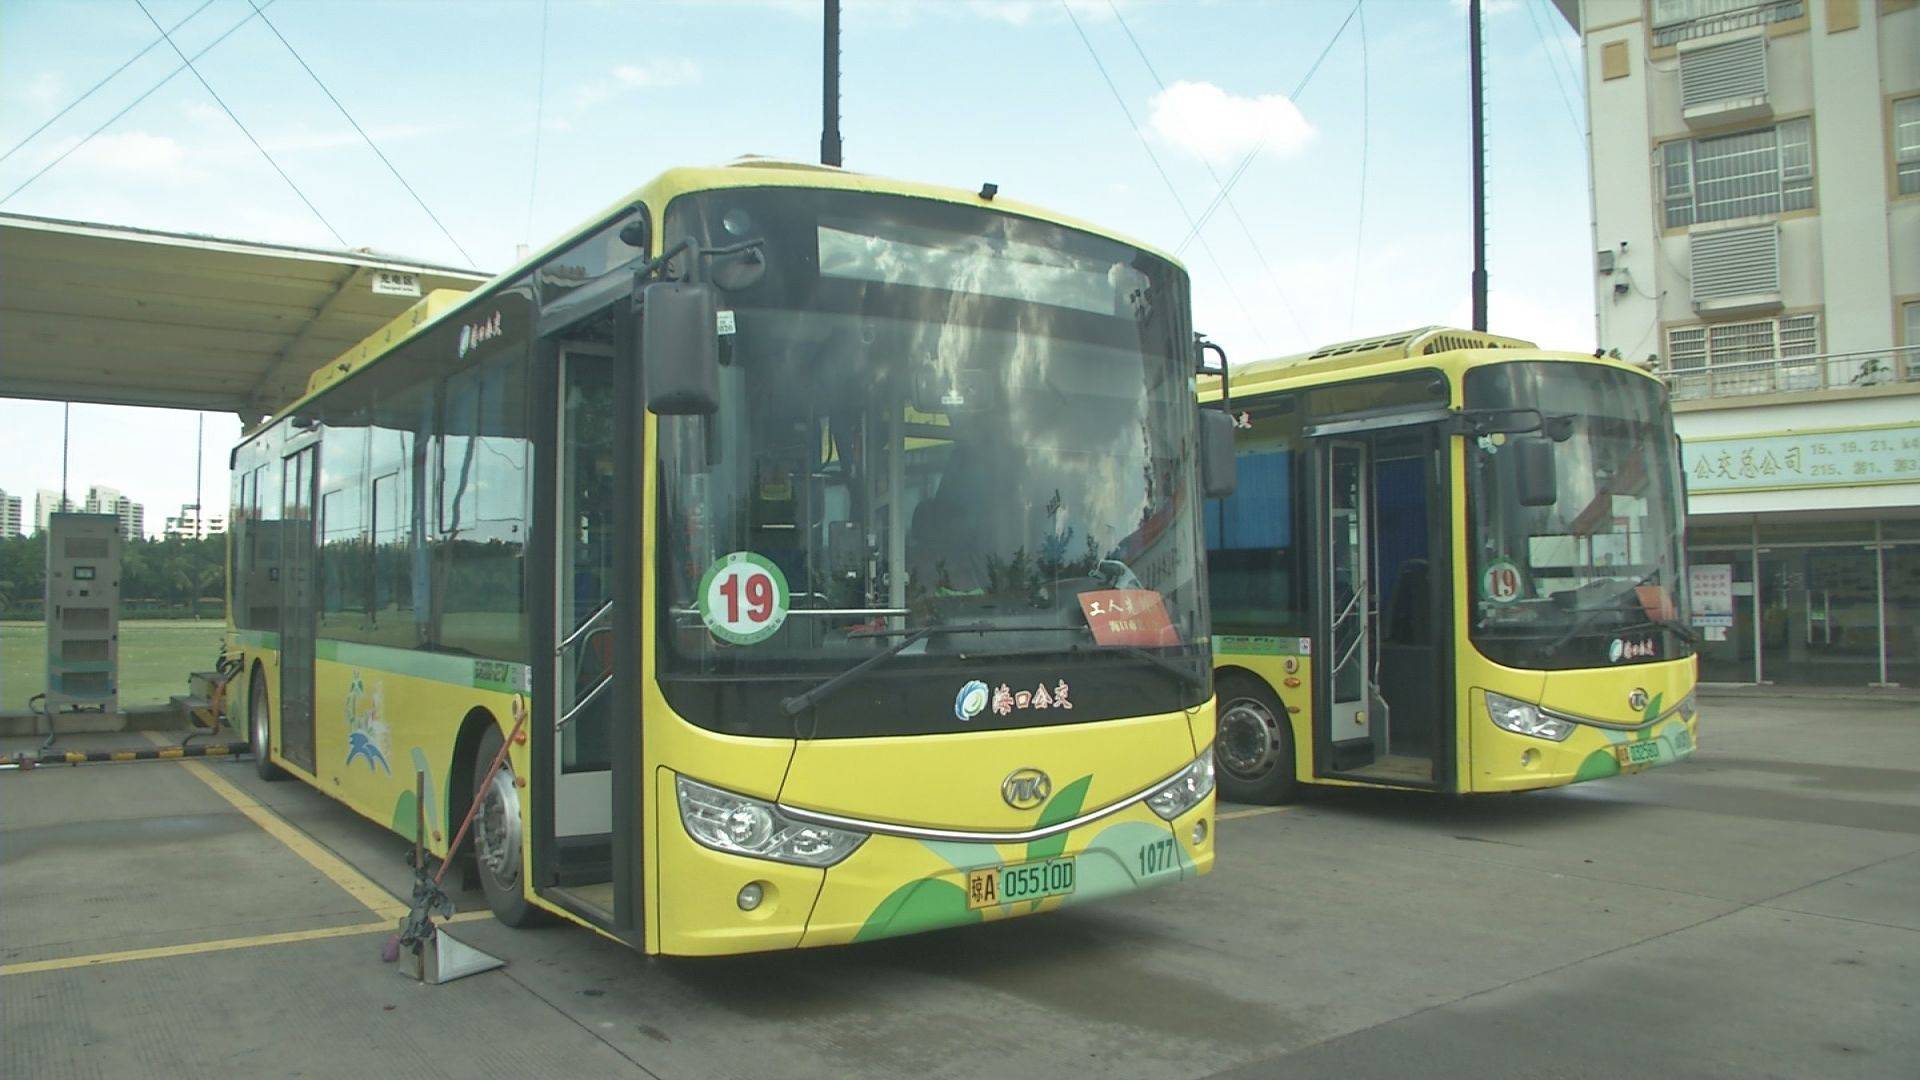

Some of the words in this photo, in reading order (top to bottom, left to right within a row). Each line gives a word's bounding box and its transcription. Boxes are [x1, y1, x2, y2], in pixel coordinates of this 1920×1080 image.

[1694, 446, 1803, 480] 公交总公司
[720, 573, 773, 623] 19
[1489, 569, 1517, 597] 19
[992, 679, 1073, 716] 海口公交
[1138, 838, 1174, 876] 1077
